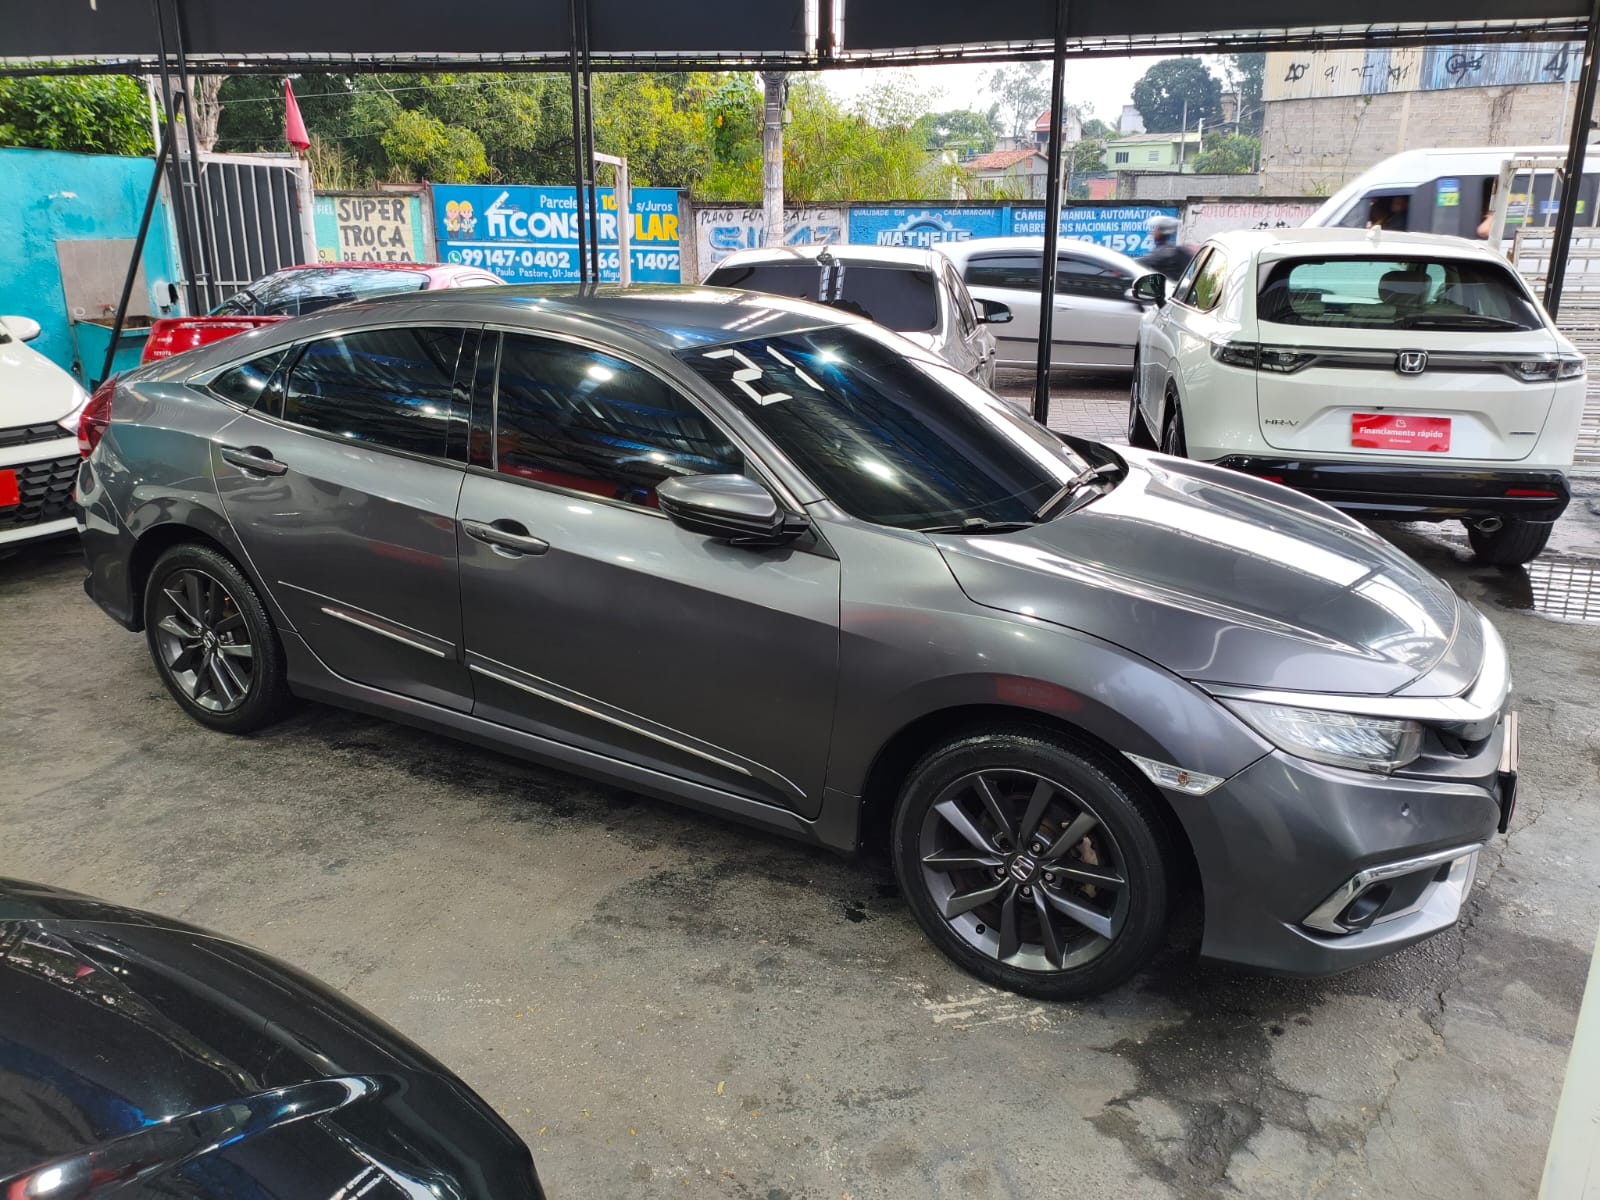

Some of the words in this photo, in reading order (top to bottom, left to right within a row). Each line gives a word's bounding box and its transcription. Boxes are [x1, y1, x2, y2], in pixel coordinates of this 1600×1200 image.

[337, 199, 406, 224] SUPER
[636, 199, 673, 213] s/Juros
[1060, 210, 1097, 221] MANUAL
[1075, 222, 1119, 232] NACIONAIS
[340, 225, 406, 248] TROCA
[343, 252, 357, 262] DE
[495, 267, 516, 277] Paulo
[1264, 418, 1299, 427] HR-V
[1359, 426, 1416, 438] Financiamento
